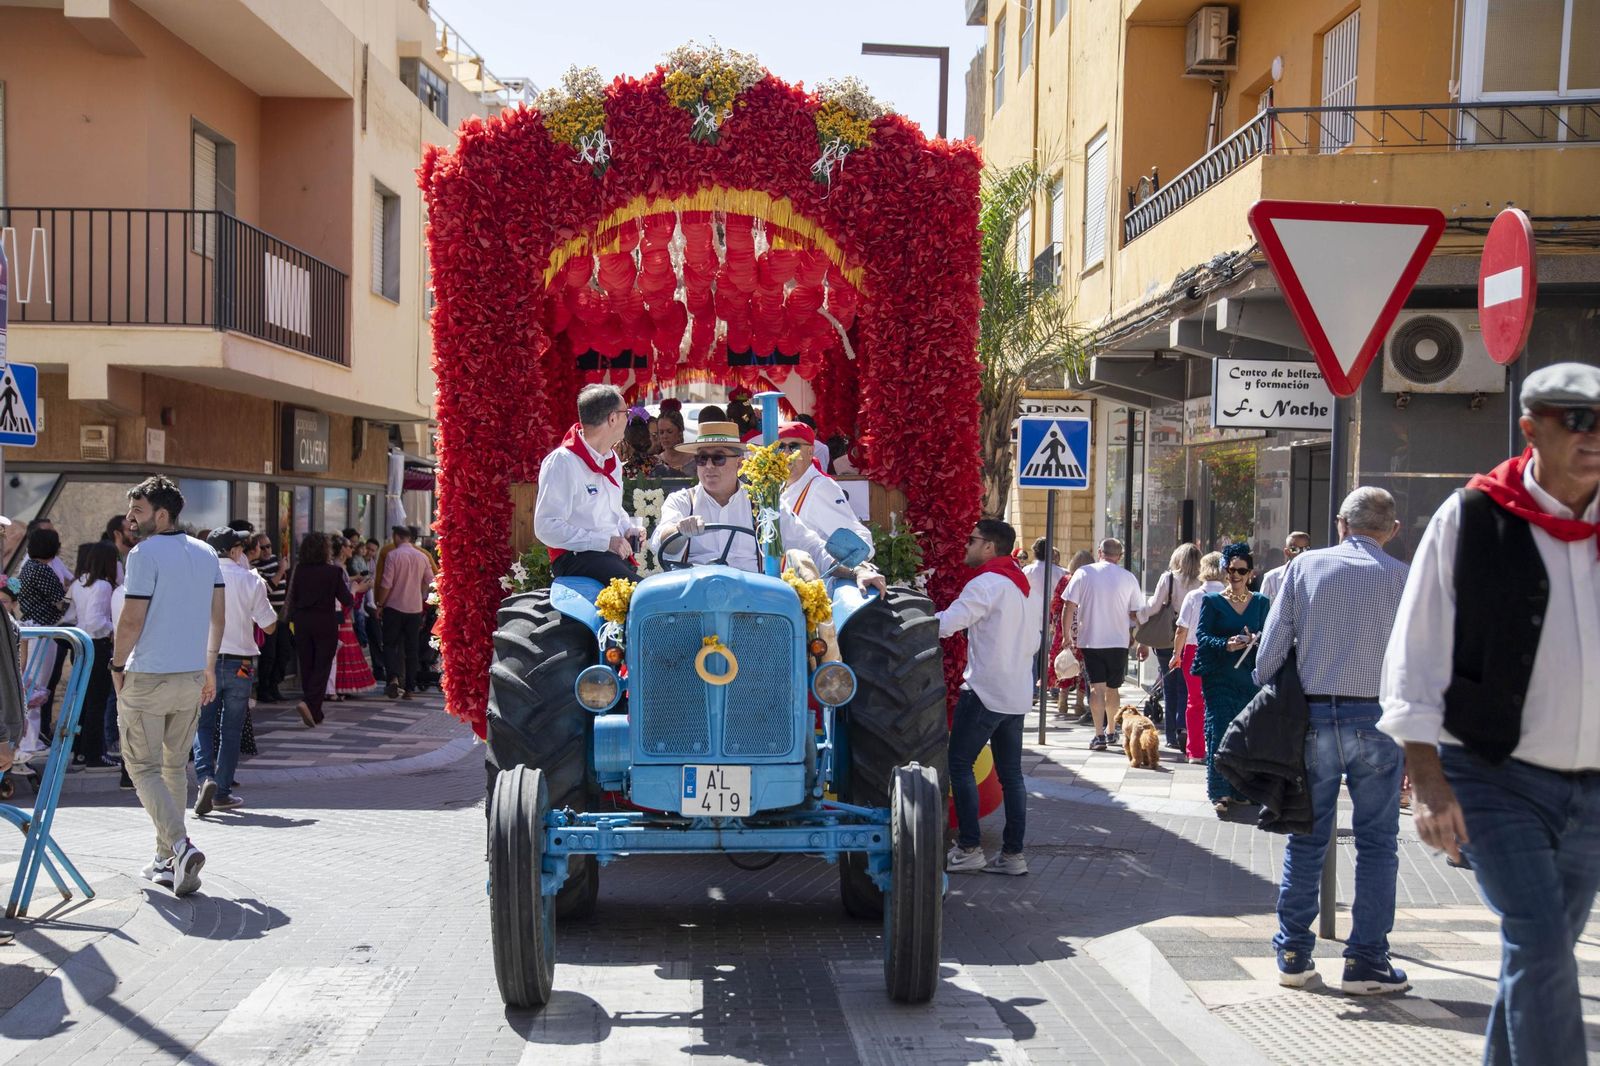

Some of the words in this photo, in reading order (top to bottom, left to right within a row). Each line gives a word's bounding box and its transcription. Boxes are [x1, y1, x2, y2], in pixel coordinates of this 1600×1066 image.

[1229, 366, 1267, 379] Centro
[1271, 368, 1284, 377] de
[1287, 368, 1324, 379] belleza
[1245, 380, 1252, 390] y
[1256, 379, 1310, 390] formación
[1260, 399, 1328, 419] Nache
[299, 438, 328, 465] OLVERA
[686, 785, 693, 793] E
[706, 770, 731, 790] AL
[701, 792, 741, 813] 419
